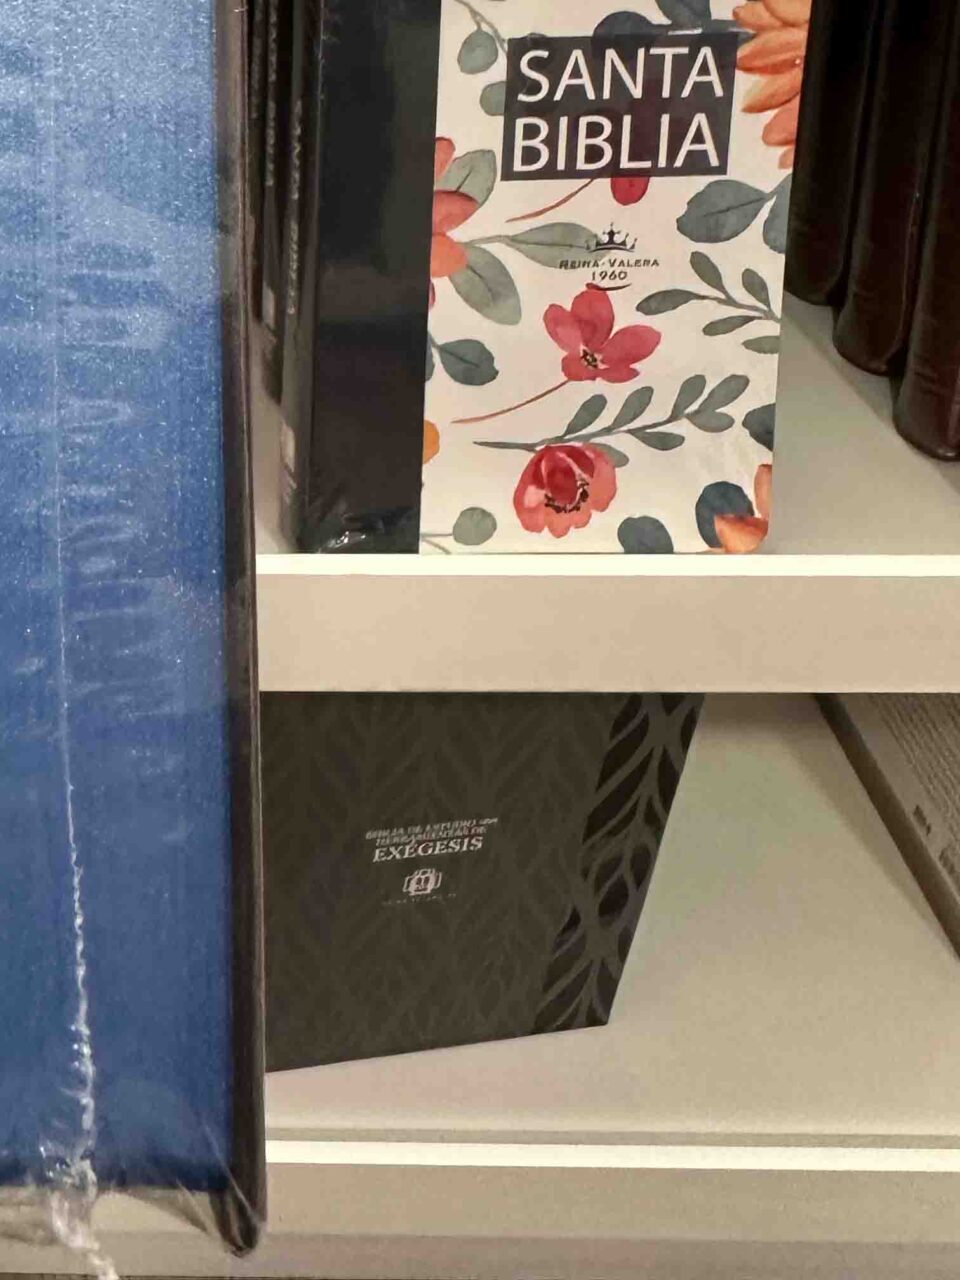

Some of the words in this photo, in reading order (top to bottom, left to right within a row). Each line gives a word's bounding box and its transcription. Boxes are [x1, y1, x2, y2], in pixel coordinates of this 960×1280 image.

[517, 46, 724, 103] SANTA
[513, 112, 720, 172] BIBLIA
[591, 270, 628, 281] 1960
